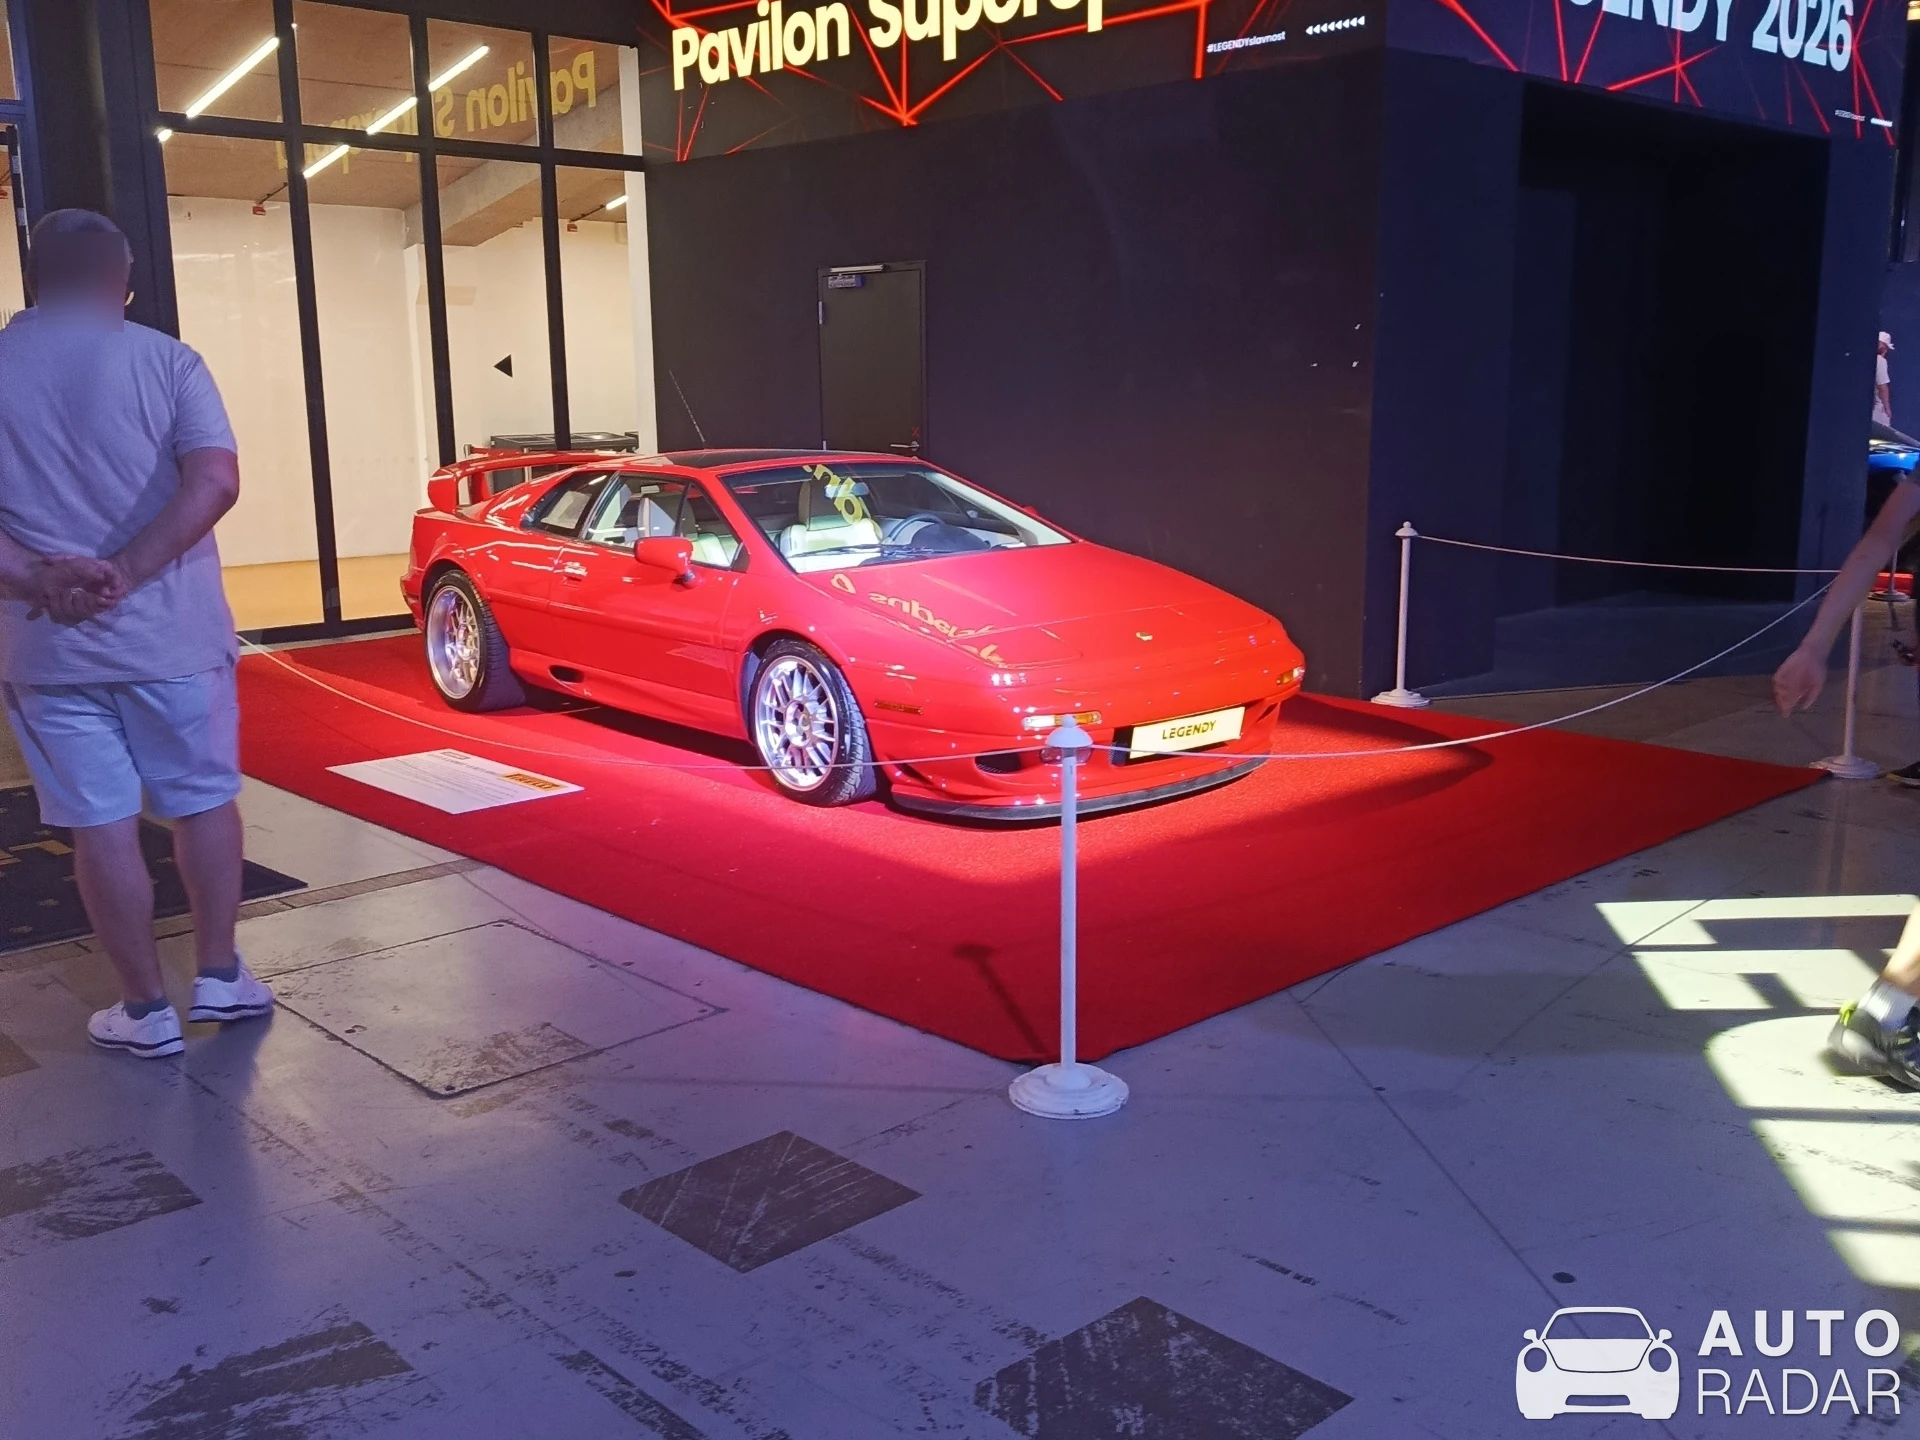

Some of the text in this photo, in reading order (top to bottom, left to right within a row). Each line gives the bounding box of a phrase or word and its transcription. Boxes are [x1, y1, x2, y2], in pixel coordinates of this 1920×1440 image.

[673, 0, 849, 90] Pavilon
[1207, 31, 1286, 53] #LEGENDYslavnost
[1752, 0, 1854, 71] 2026
[1161, 719, 1217, 740] LEGENDY
